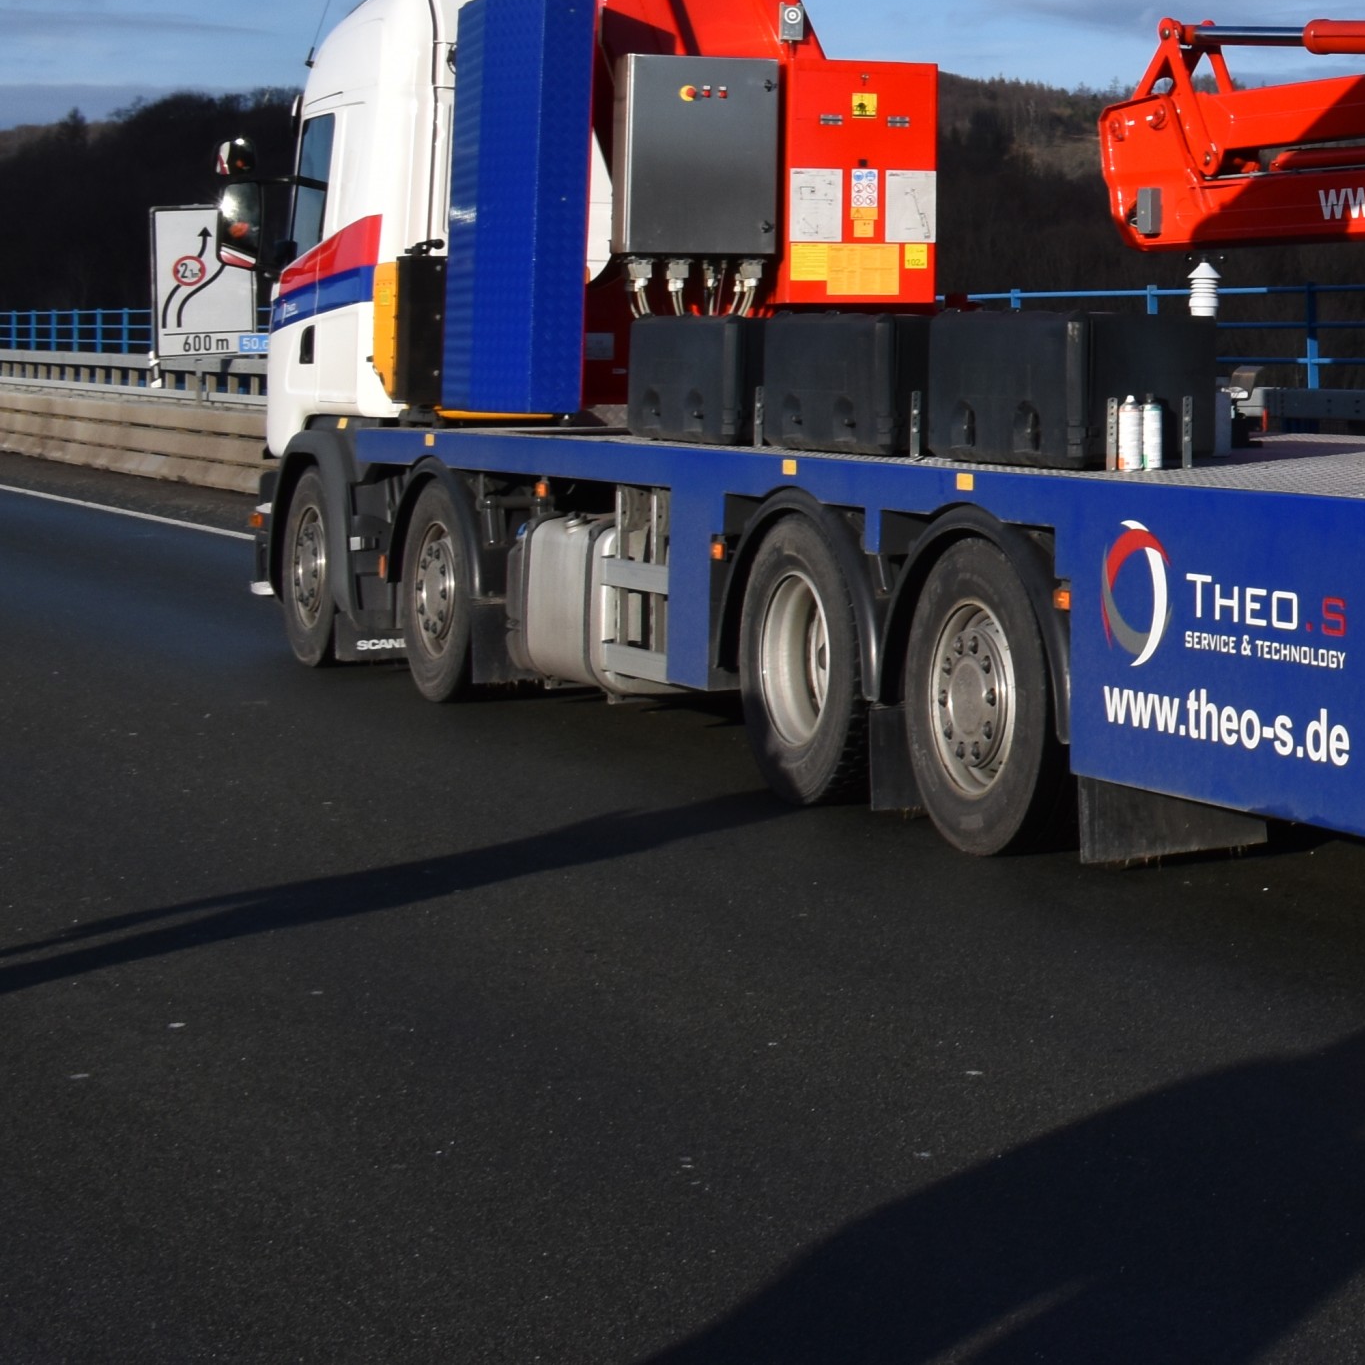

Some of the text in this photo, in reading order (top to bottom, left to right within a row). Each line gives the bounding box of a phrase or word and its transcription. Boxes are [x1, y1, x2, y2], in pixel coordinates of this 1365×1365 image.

[183, 334, 229, 353] 600 m
[356, 638, 407, 651] SCANI
[1185, 631, 1346, 669] SERVICE & TECHNOLOGY
[1104, 685, 1350, 767] www.theo-s.de
